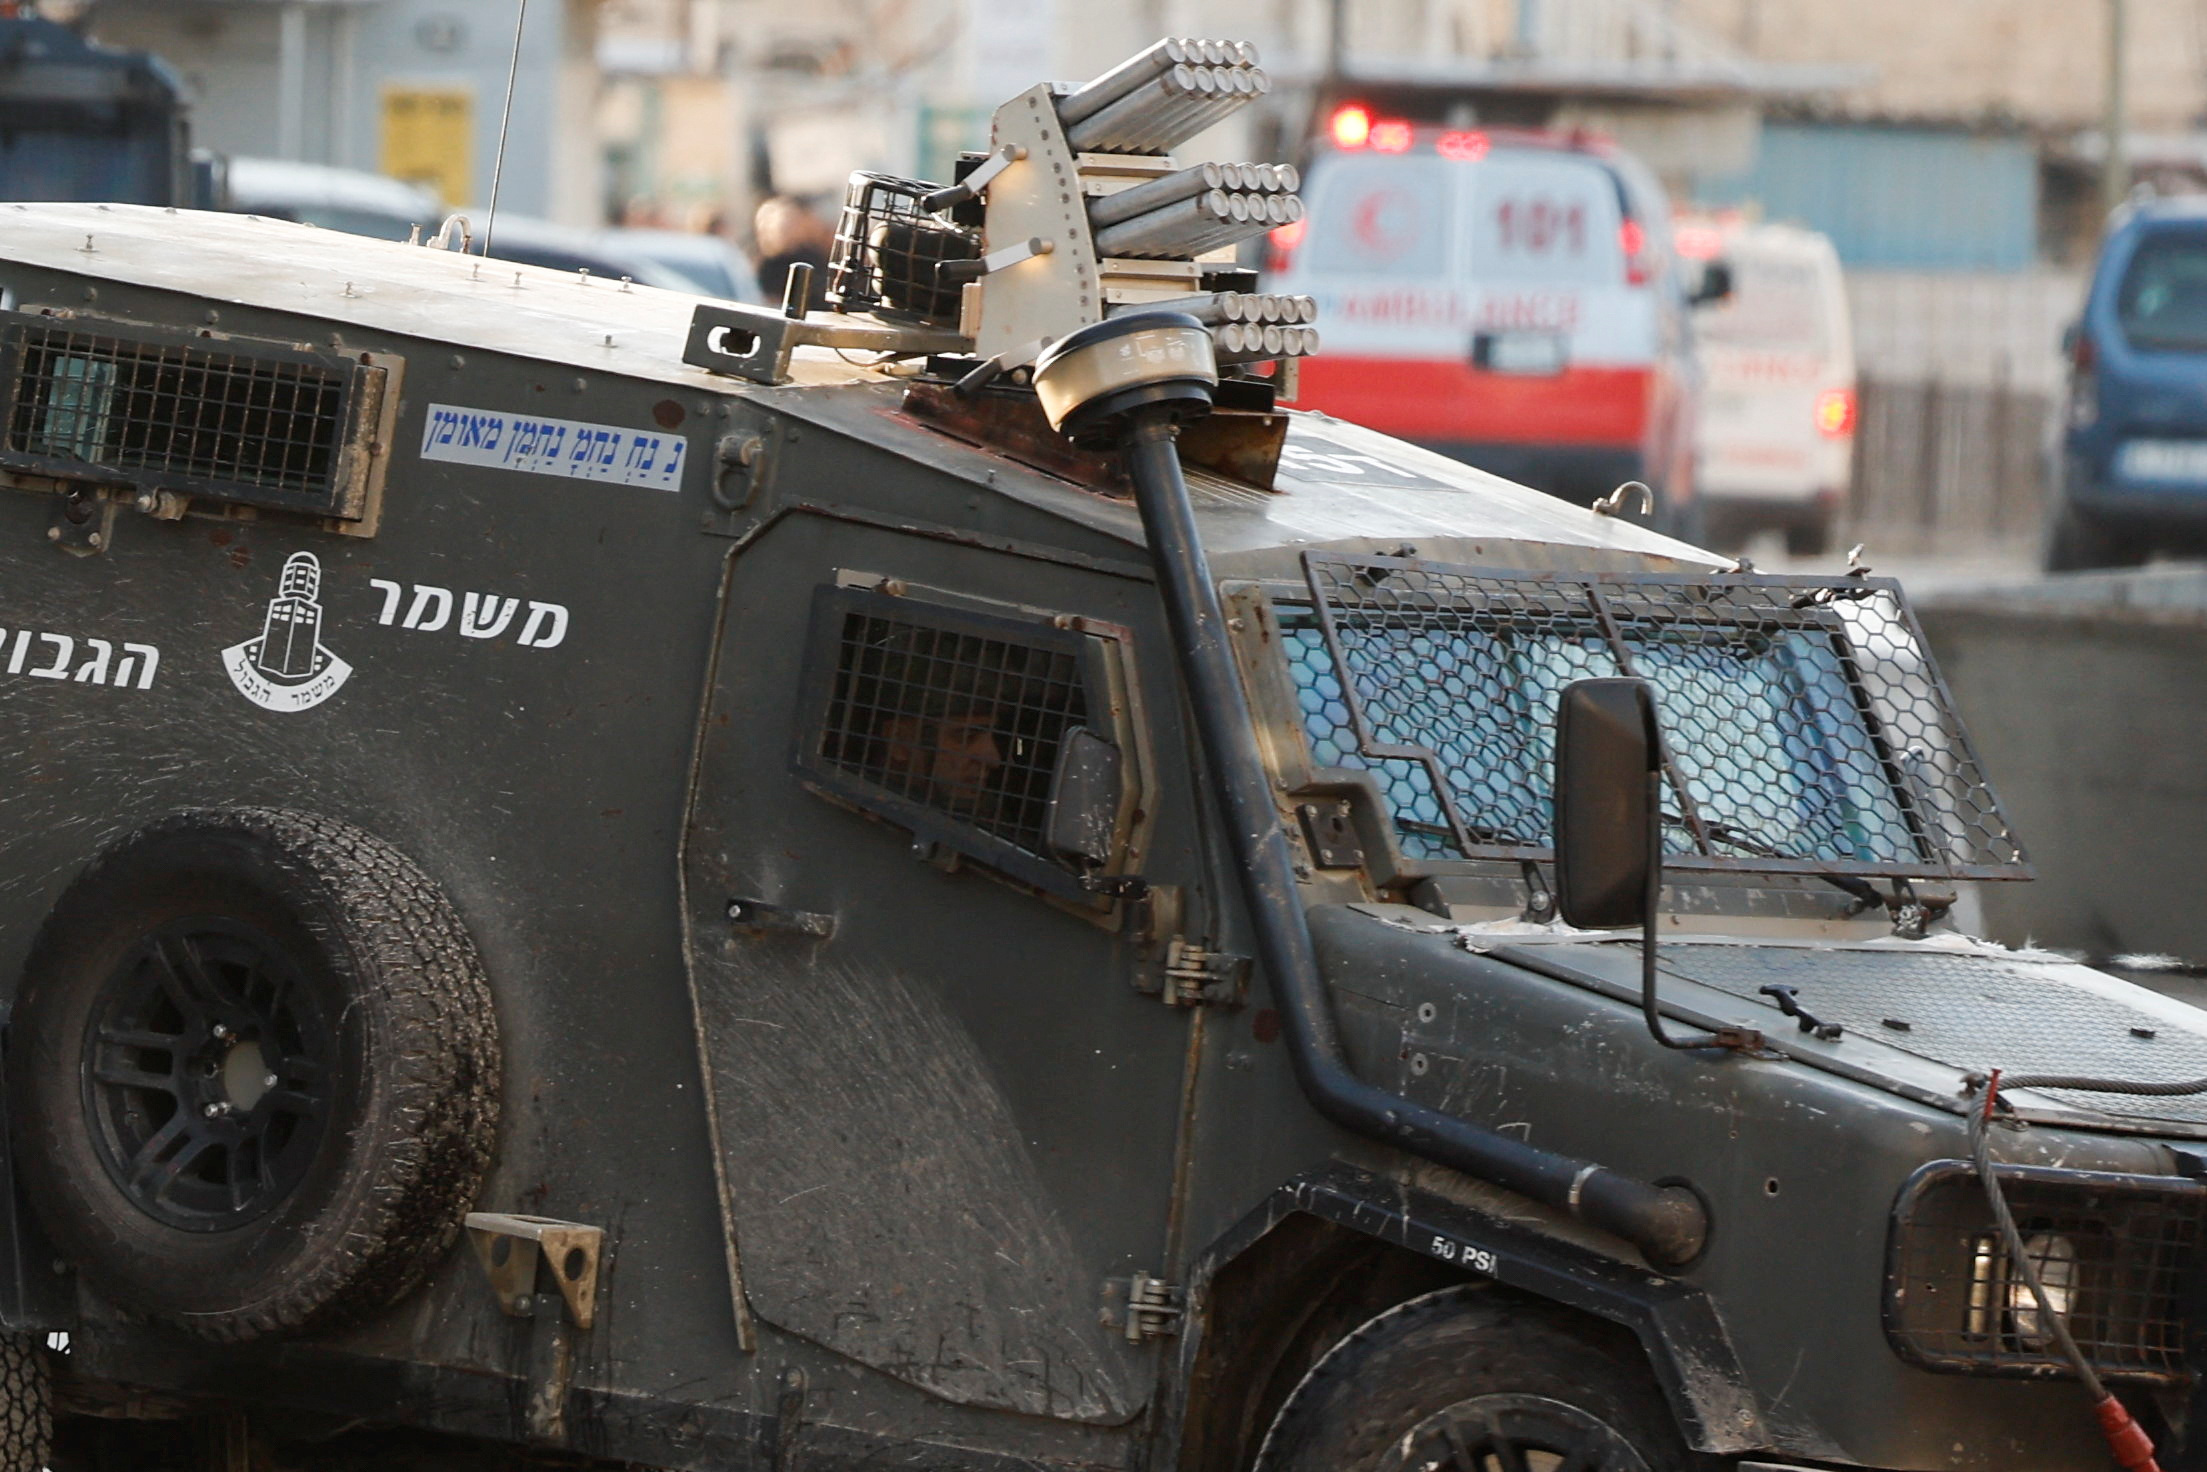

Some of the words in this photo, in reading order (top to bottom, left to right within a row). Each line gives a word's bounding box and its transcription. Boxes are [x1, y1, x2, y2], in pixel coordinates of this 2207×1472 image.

[369, 578, 569, 648] משמר
[234, 658, 271, 702] הגבול
[291, 676, 335, 705] משמר
[1431, 1235, 1456, 1260] 50
[1462, 1245, 1498, 1275] PSI
